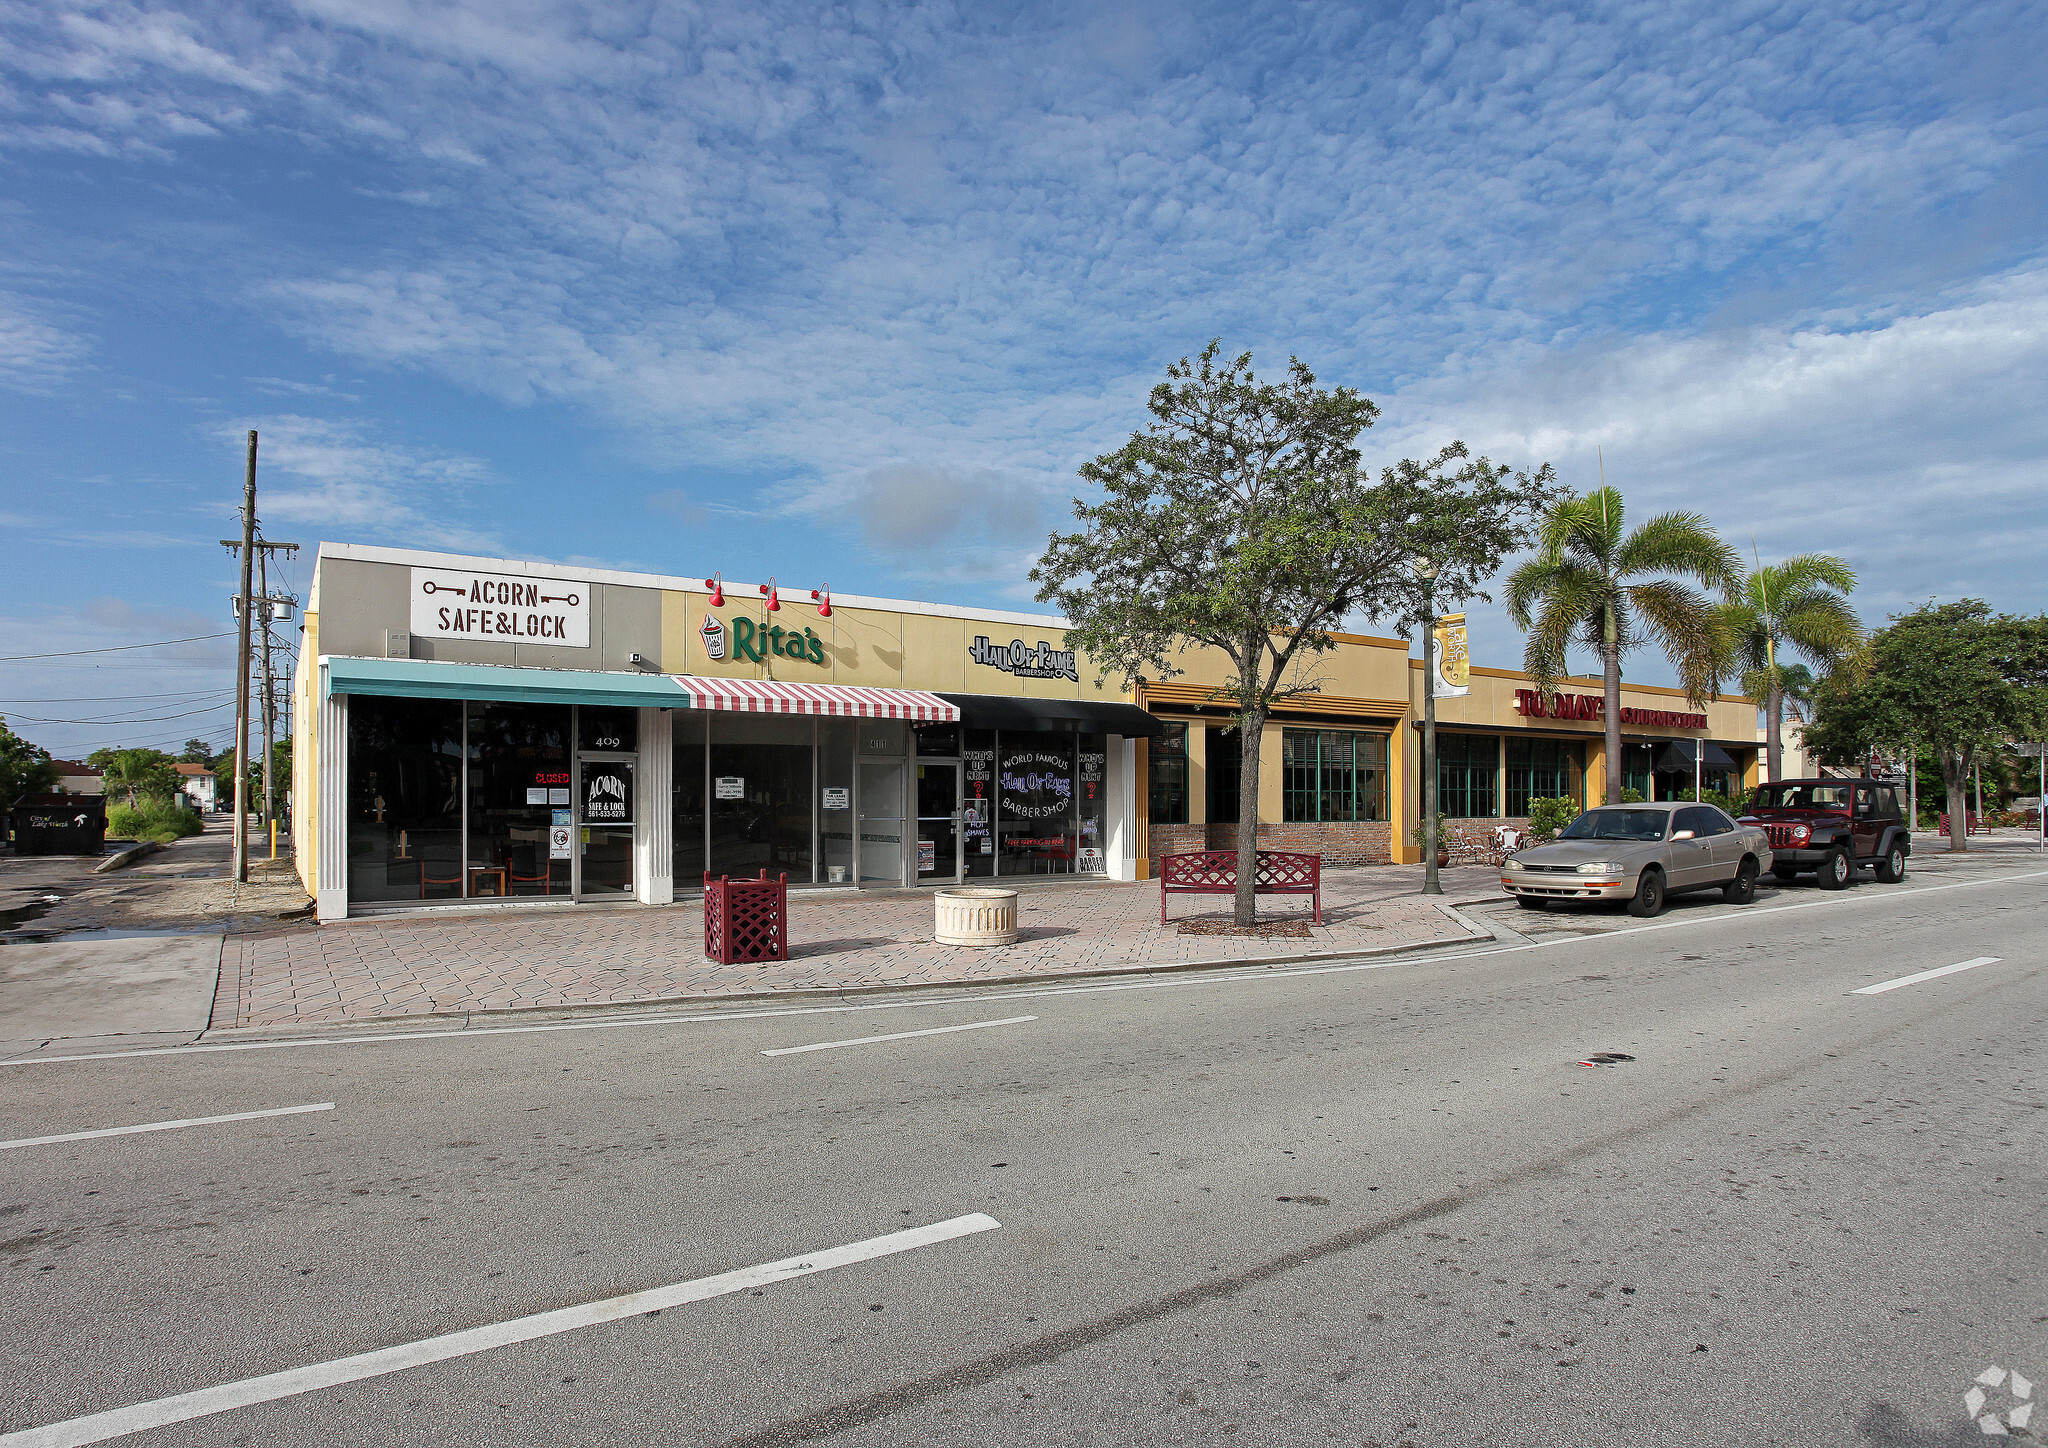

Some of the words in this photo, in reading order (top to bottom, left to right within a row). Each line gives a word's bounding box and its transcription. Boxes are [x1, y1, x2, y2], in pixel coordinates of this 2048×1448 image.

[470, 579, 538, 607] ACORN
[438, 607, 566, 639] SAFE&LOCK
[731, 616, 824, 664] Rita's
[1447, 628, 1456, 662] WORTH
[1454, 626, 1468, 660] Lake
[1620, 707, 1680, 728] GOURMET
[595, 737, 620, 748] 409
[963, 751, 994, 760] WHO'S
[1002, 753, 1033, 769] WORLD
[1035, 753, 1069, 770] FAMOUS
[971, 761, 986, 770] UP
[536, 773, 570, 784] CLOSED
[588, 775, 626, 803] ACORN
[588, 802, 602, 811] SAFE
[603, 802, 609, 811] &
[610, 802, 626, 811] LOCK
[588, 810, 626, 818] 561-533-5276
[1002, 798, 1041, 817] BARBER
[1042, 798, 1069, 817] SHOP
